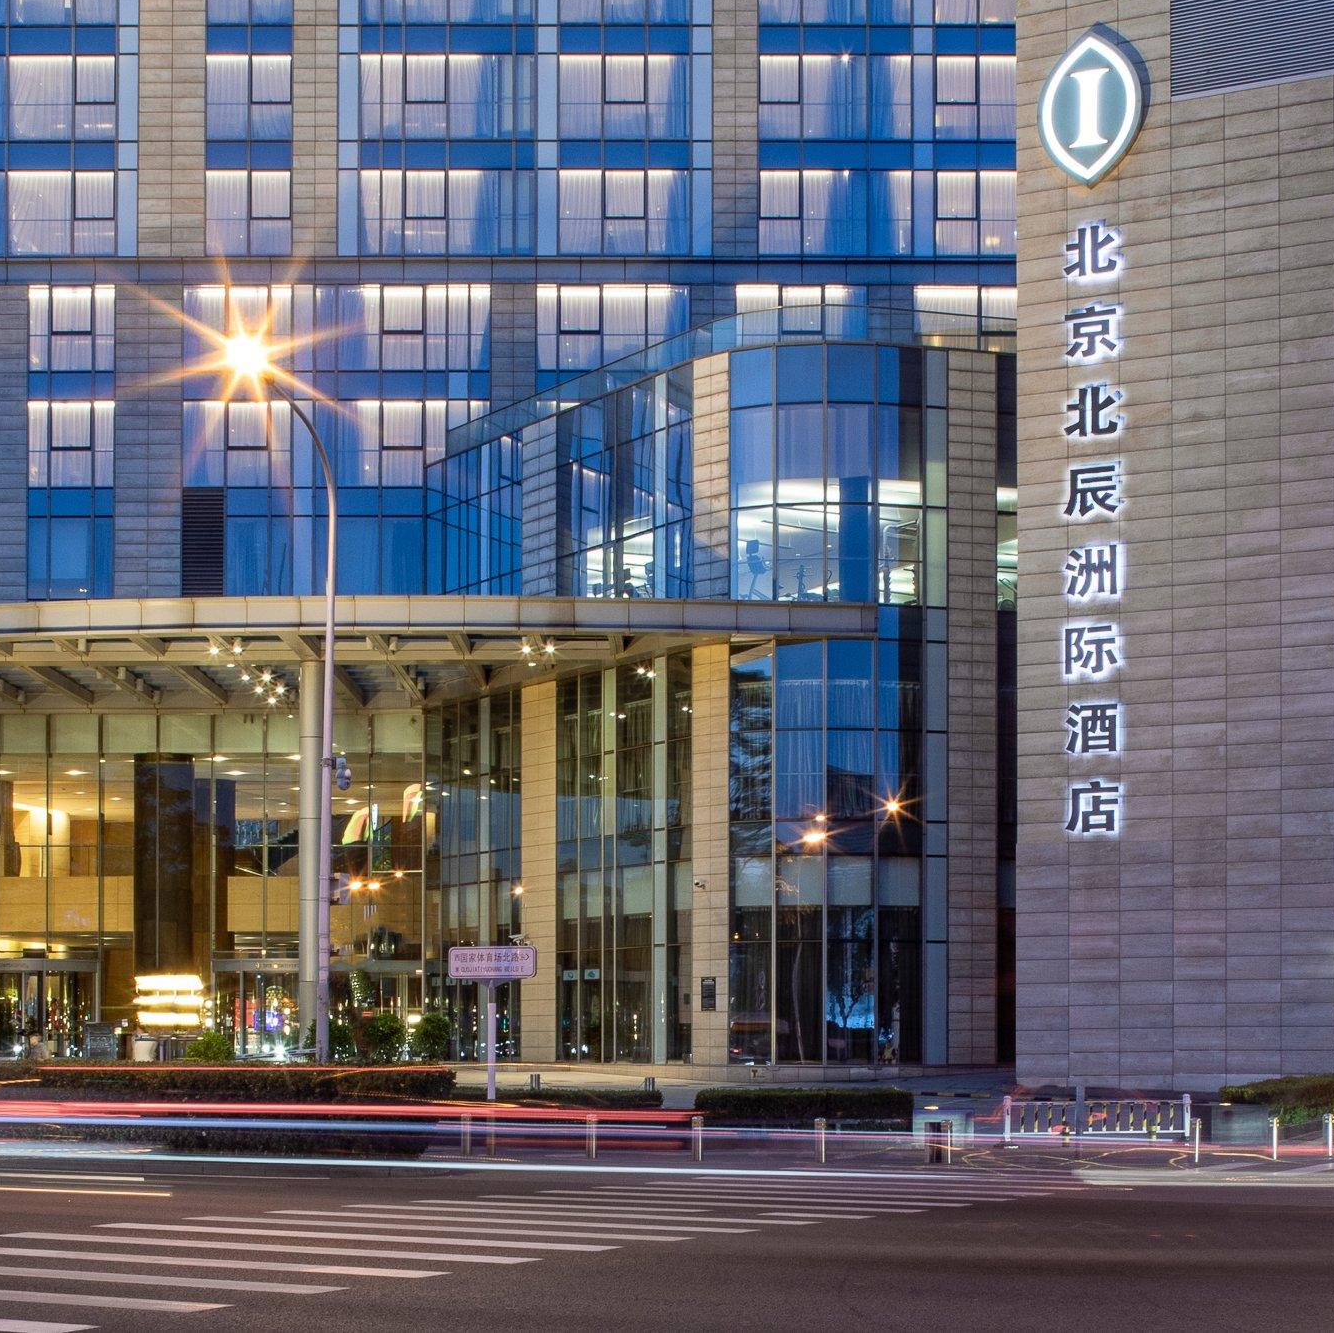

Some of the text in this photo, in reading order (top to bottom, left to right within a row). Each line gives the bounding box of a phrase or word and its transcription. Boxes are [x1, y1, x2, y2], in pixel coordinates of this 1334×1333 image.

[1063, 219, 1119, 833] 北京北辰洲际酒店
[461, 953, 519, 963] 国家体育场北路
